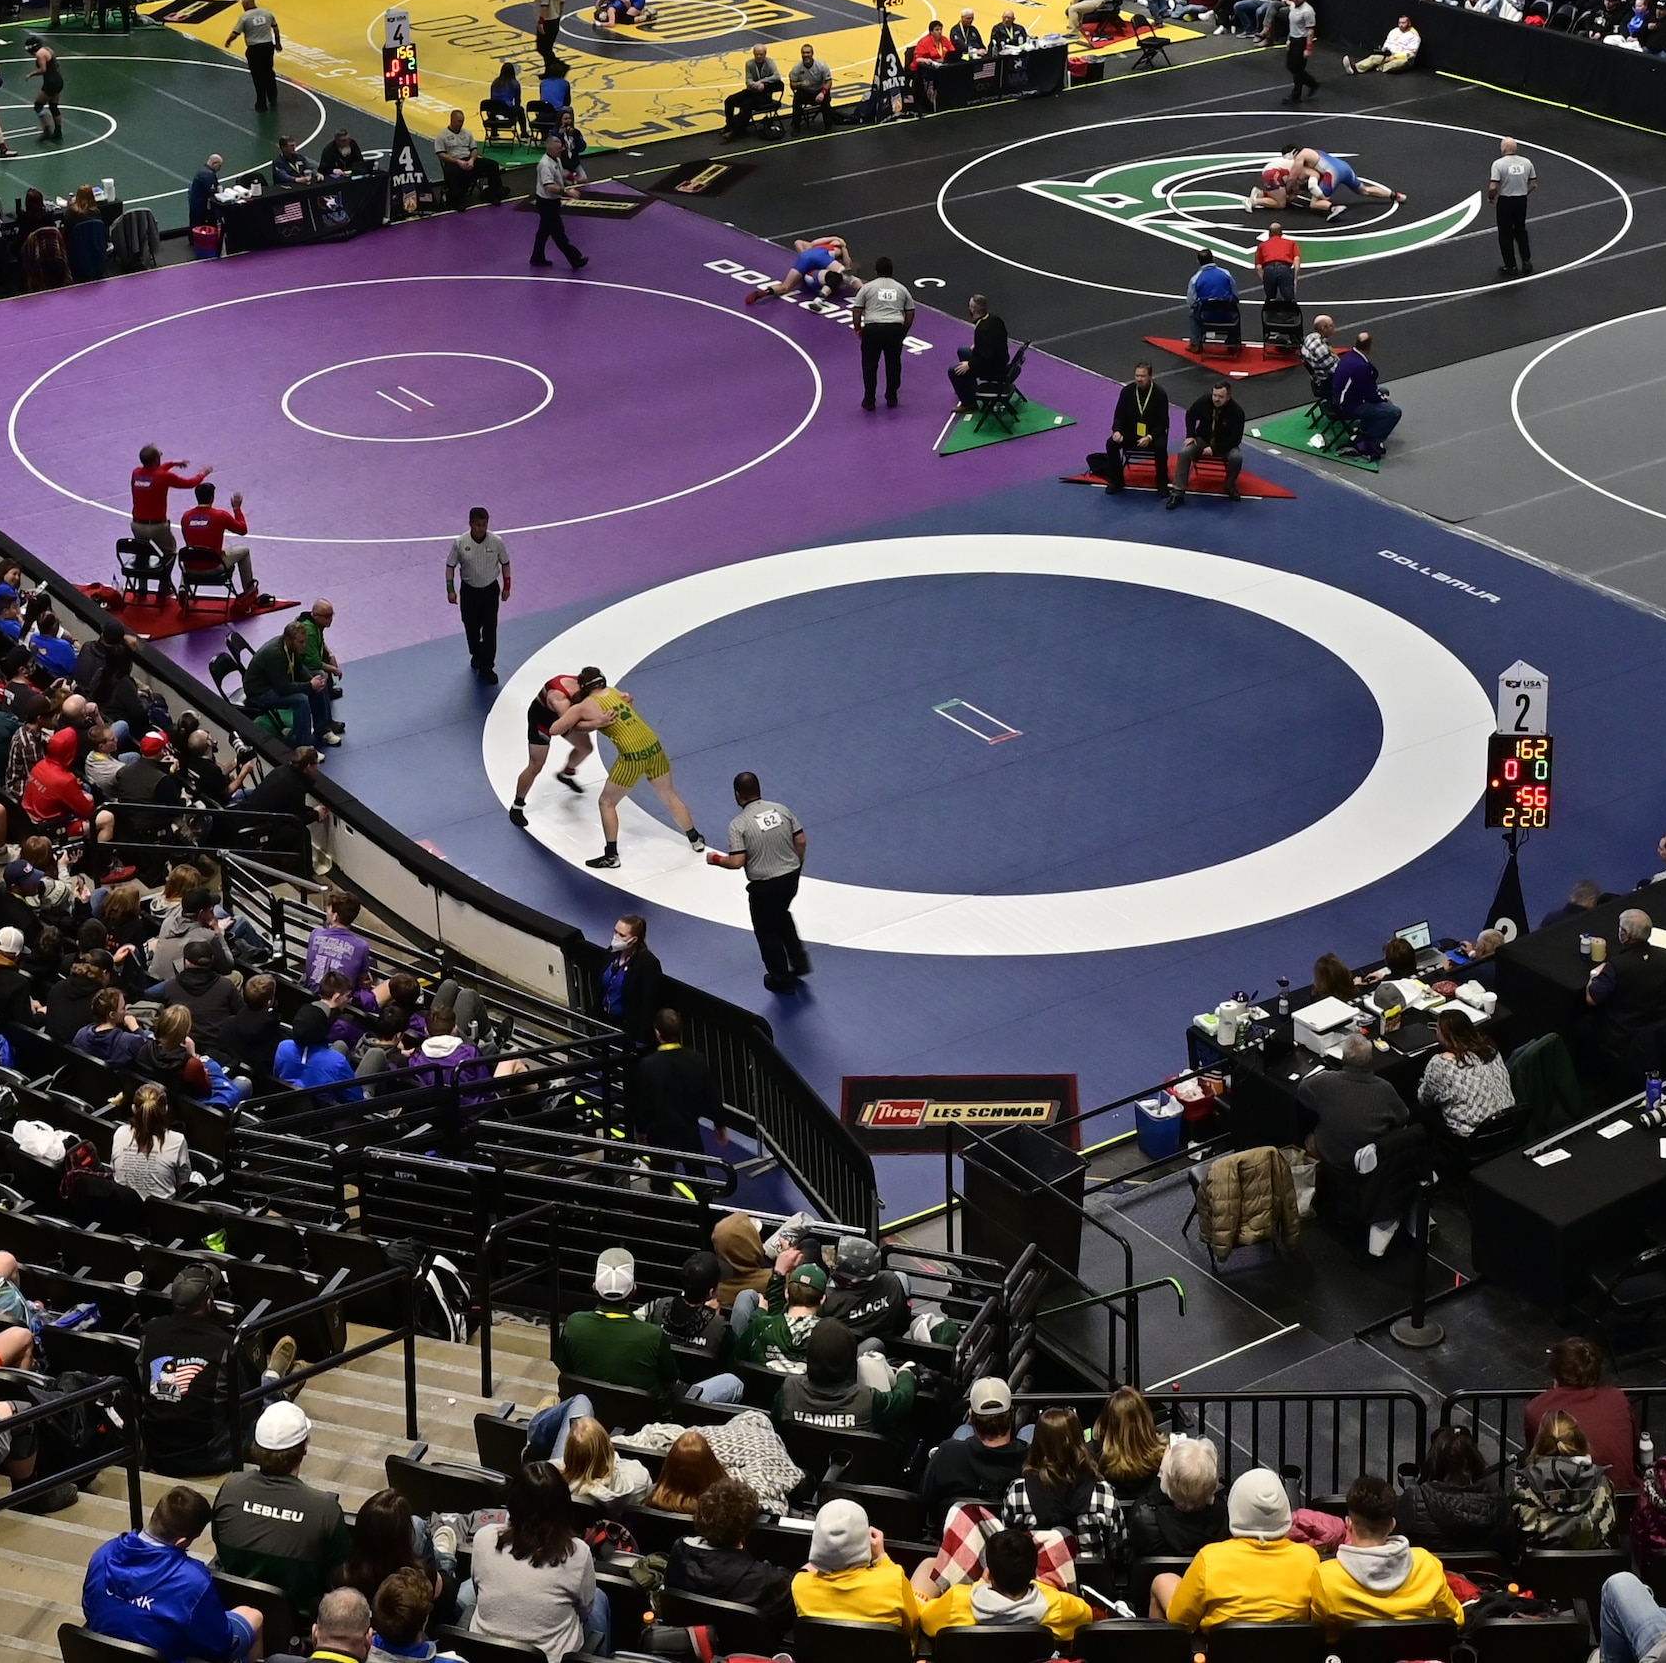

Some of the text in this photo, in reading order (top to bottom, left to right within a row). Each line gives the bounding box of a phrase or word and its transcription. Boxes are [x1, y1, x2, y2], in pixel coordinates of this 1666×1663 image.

[393, 24, 404, 45] 4
[397, 46, 414, 59] 156
[886, 53, 897, 76] 3
[399, 73, 417, 85] :11
[882, 76, 906, 91] MAT
[397, 87, 410, 99] 18
[398, 146, 414, 171] 4
[393, 172, 423, 188] MAT
[1378, 549, 1501, 604] DOLLAMUR
[1522, 680, 1541, 688] USA
[1513, 693, 1530, 733] 2
[1515, 739, 1547, 760] 162
[1504, 759, 1548, 781] 0 0
[1515, 786, 1547, 807] :56
[764, 815, 778, 827] 62
[1503, 807, 1546, 828] 220
[878, 1102, 1045, 1124] Tires LES SCHWAB
[849, 1295, 890, 1320] BLACK
[243, 1500, 304, 1523] LEBLEU
